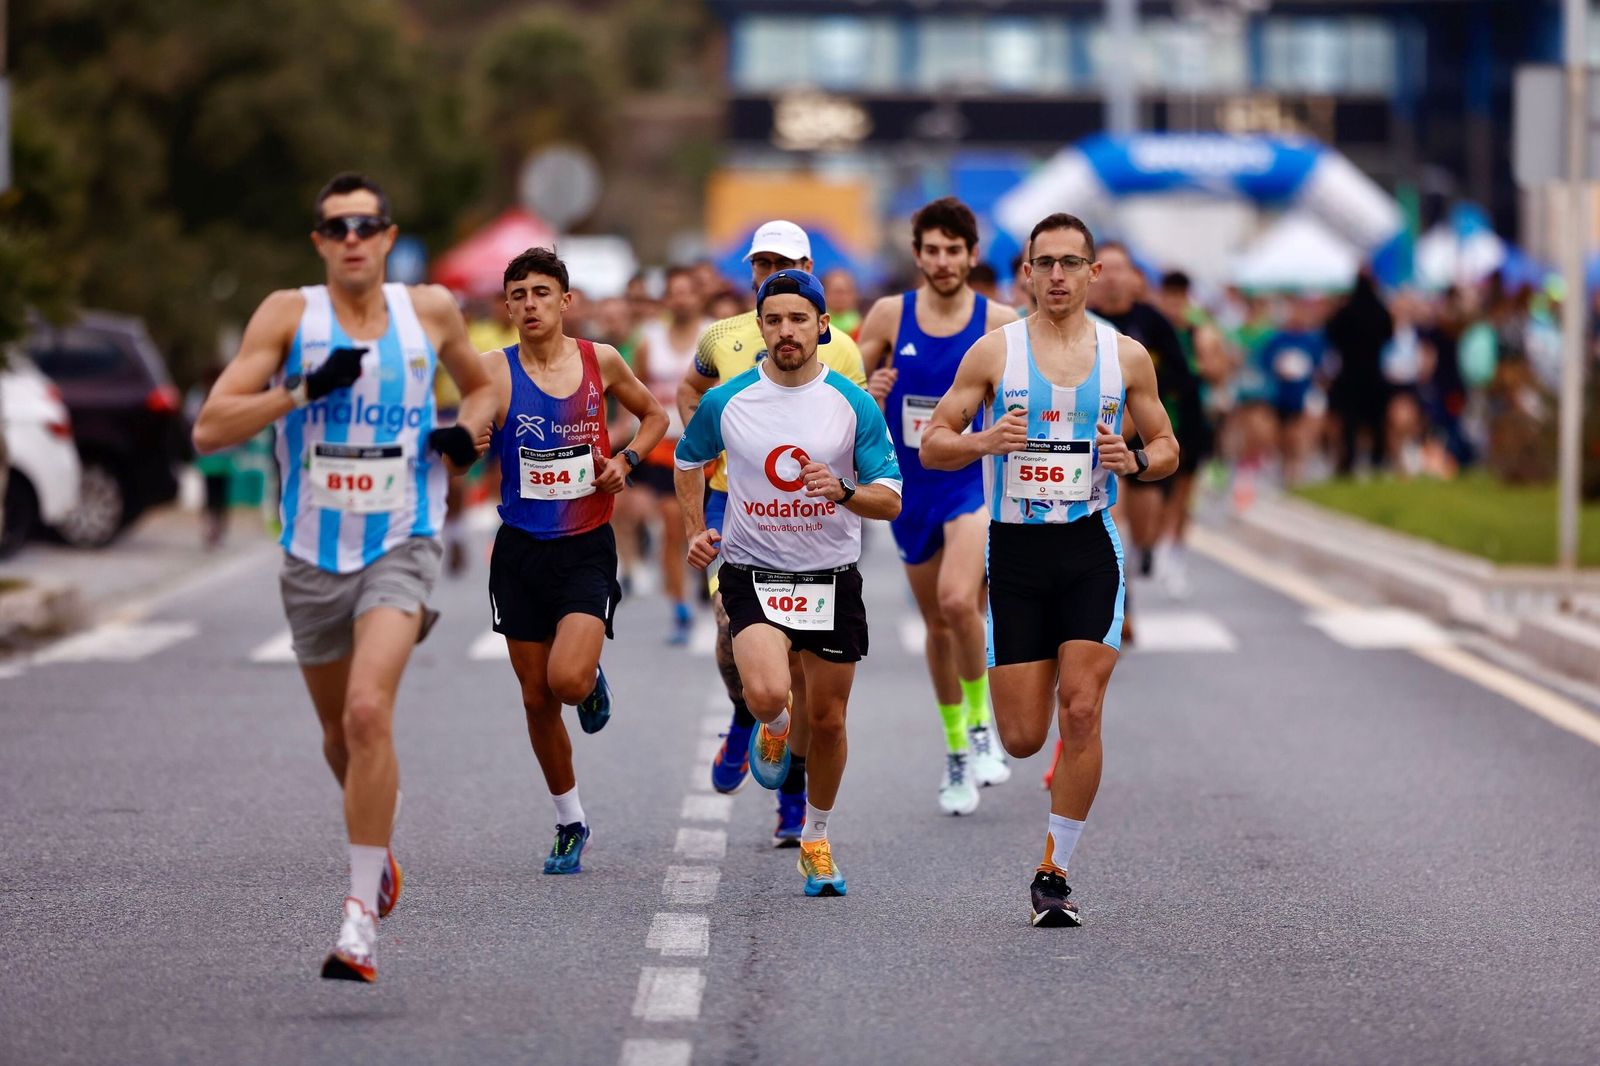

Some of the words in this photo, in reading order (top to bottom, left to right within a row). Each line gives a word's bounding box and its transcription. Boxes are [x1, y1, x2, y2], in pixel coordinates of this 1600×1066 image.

[1005, 388, 1028, 398] vive
[551, 420, 600, 438] lapalma
[327, 473, 373, 491] 810
[529, 470, 571, 485] 384
[1019, 465, 1065, 483] 556
[743, 499, 836, 518] vodafone
[758, 522, 804, 533] Innovation
[806, 522, 823, 532] Hub
[767, 596, 808, 612] 402
